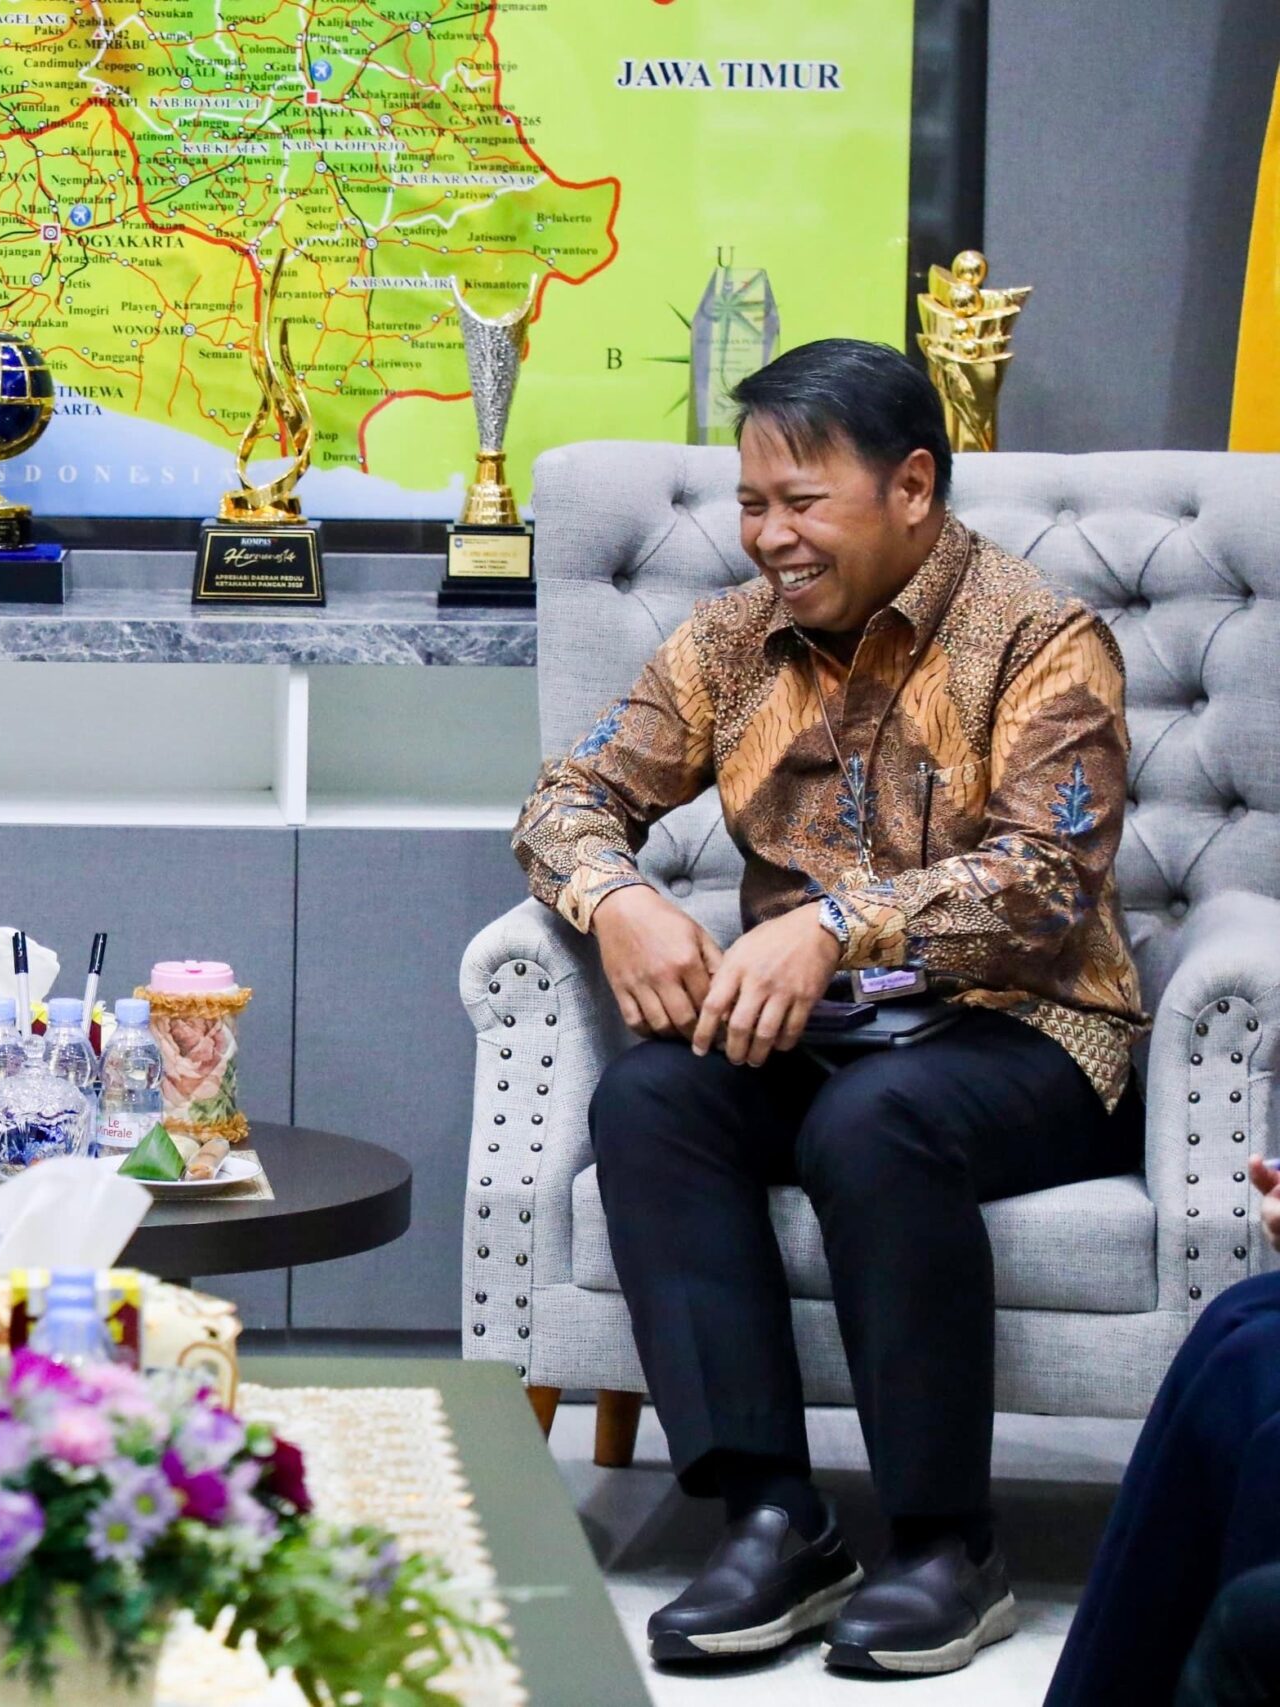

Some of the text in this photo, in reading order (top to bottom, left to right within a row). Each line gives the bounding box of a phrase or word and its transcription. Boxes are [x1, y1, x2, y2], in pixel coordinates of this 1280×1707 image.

[617, 61, 841, 89] JAWA TIMUR
[66, 235, 185, 249] YOGYAKARTA
[606, 347, 622, 370] B
[108, 1115, 120, 1128] Le
